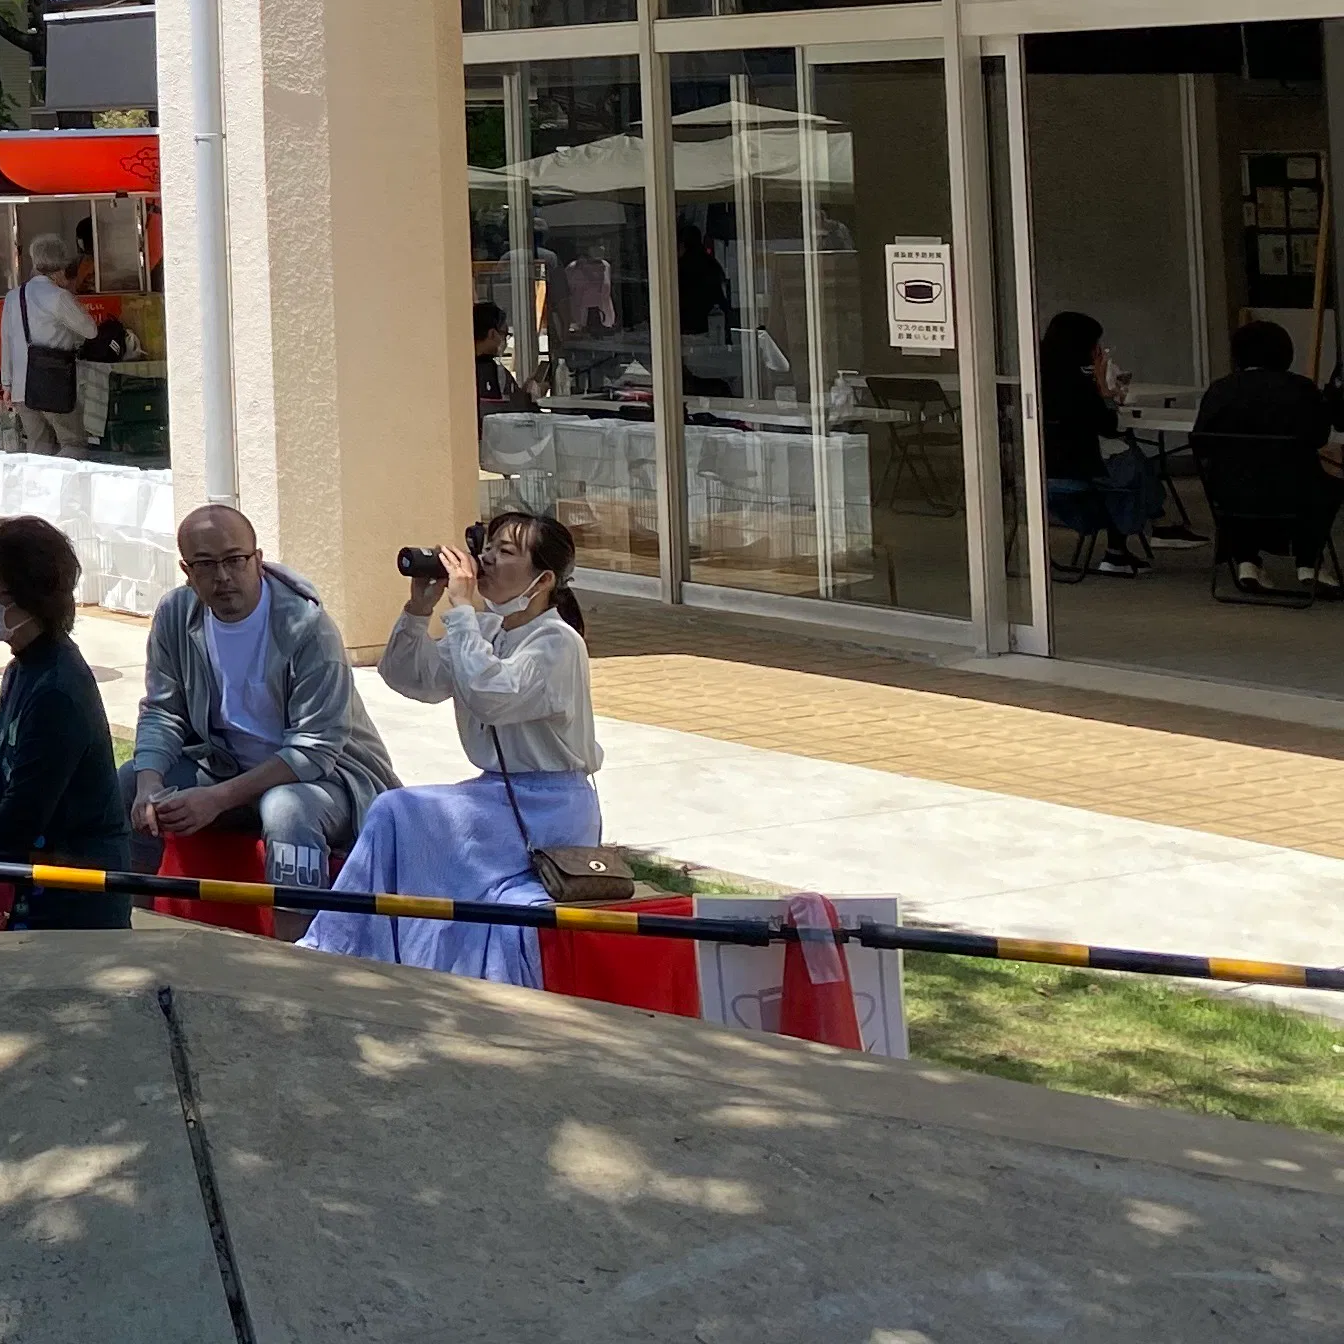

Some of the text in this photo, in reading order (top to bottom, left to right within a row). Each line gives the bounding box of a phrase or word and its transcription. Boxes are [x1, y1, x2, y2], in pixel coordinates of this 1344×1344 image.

[897, 324, 945, 333] マスクの着用を
[898, 333, 945, 341] お願いします
